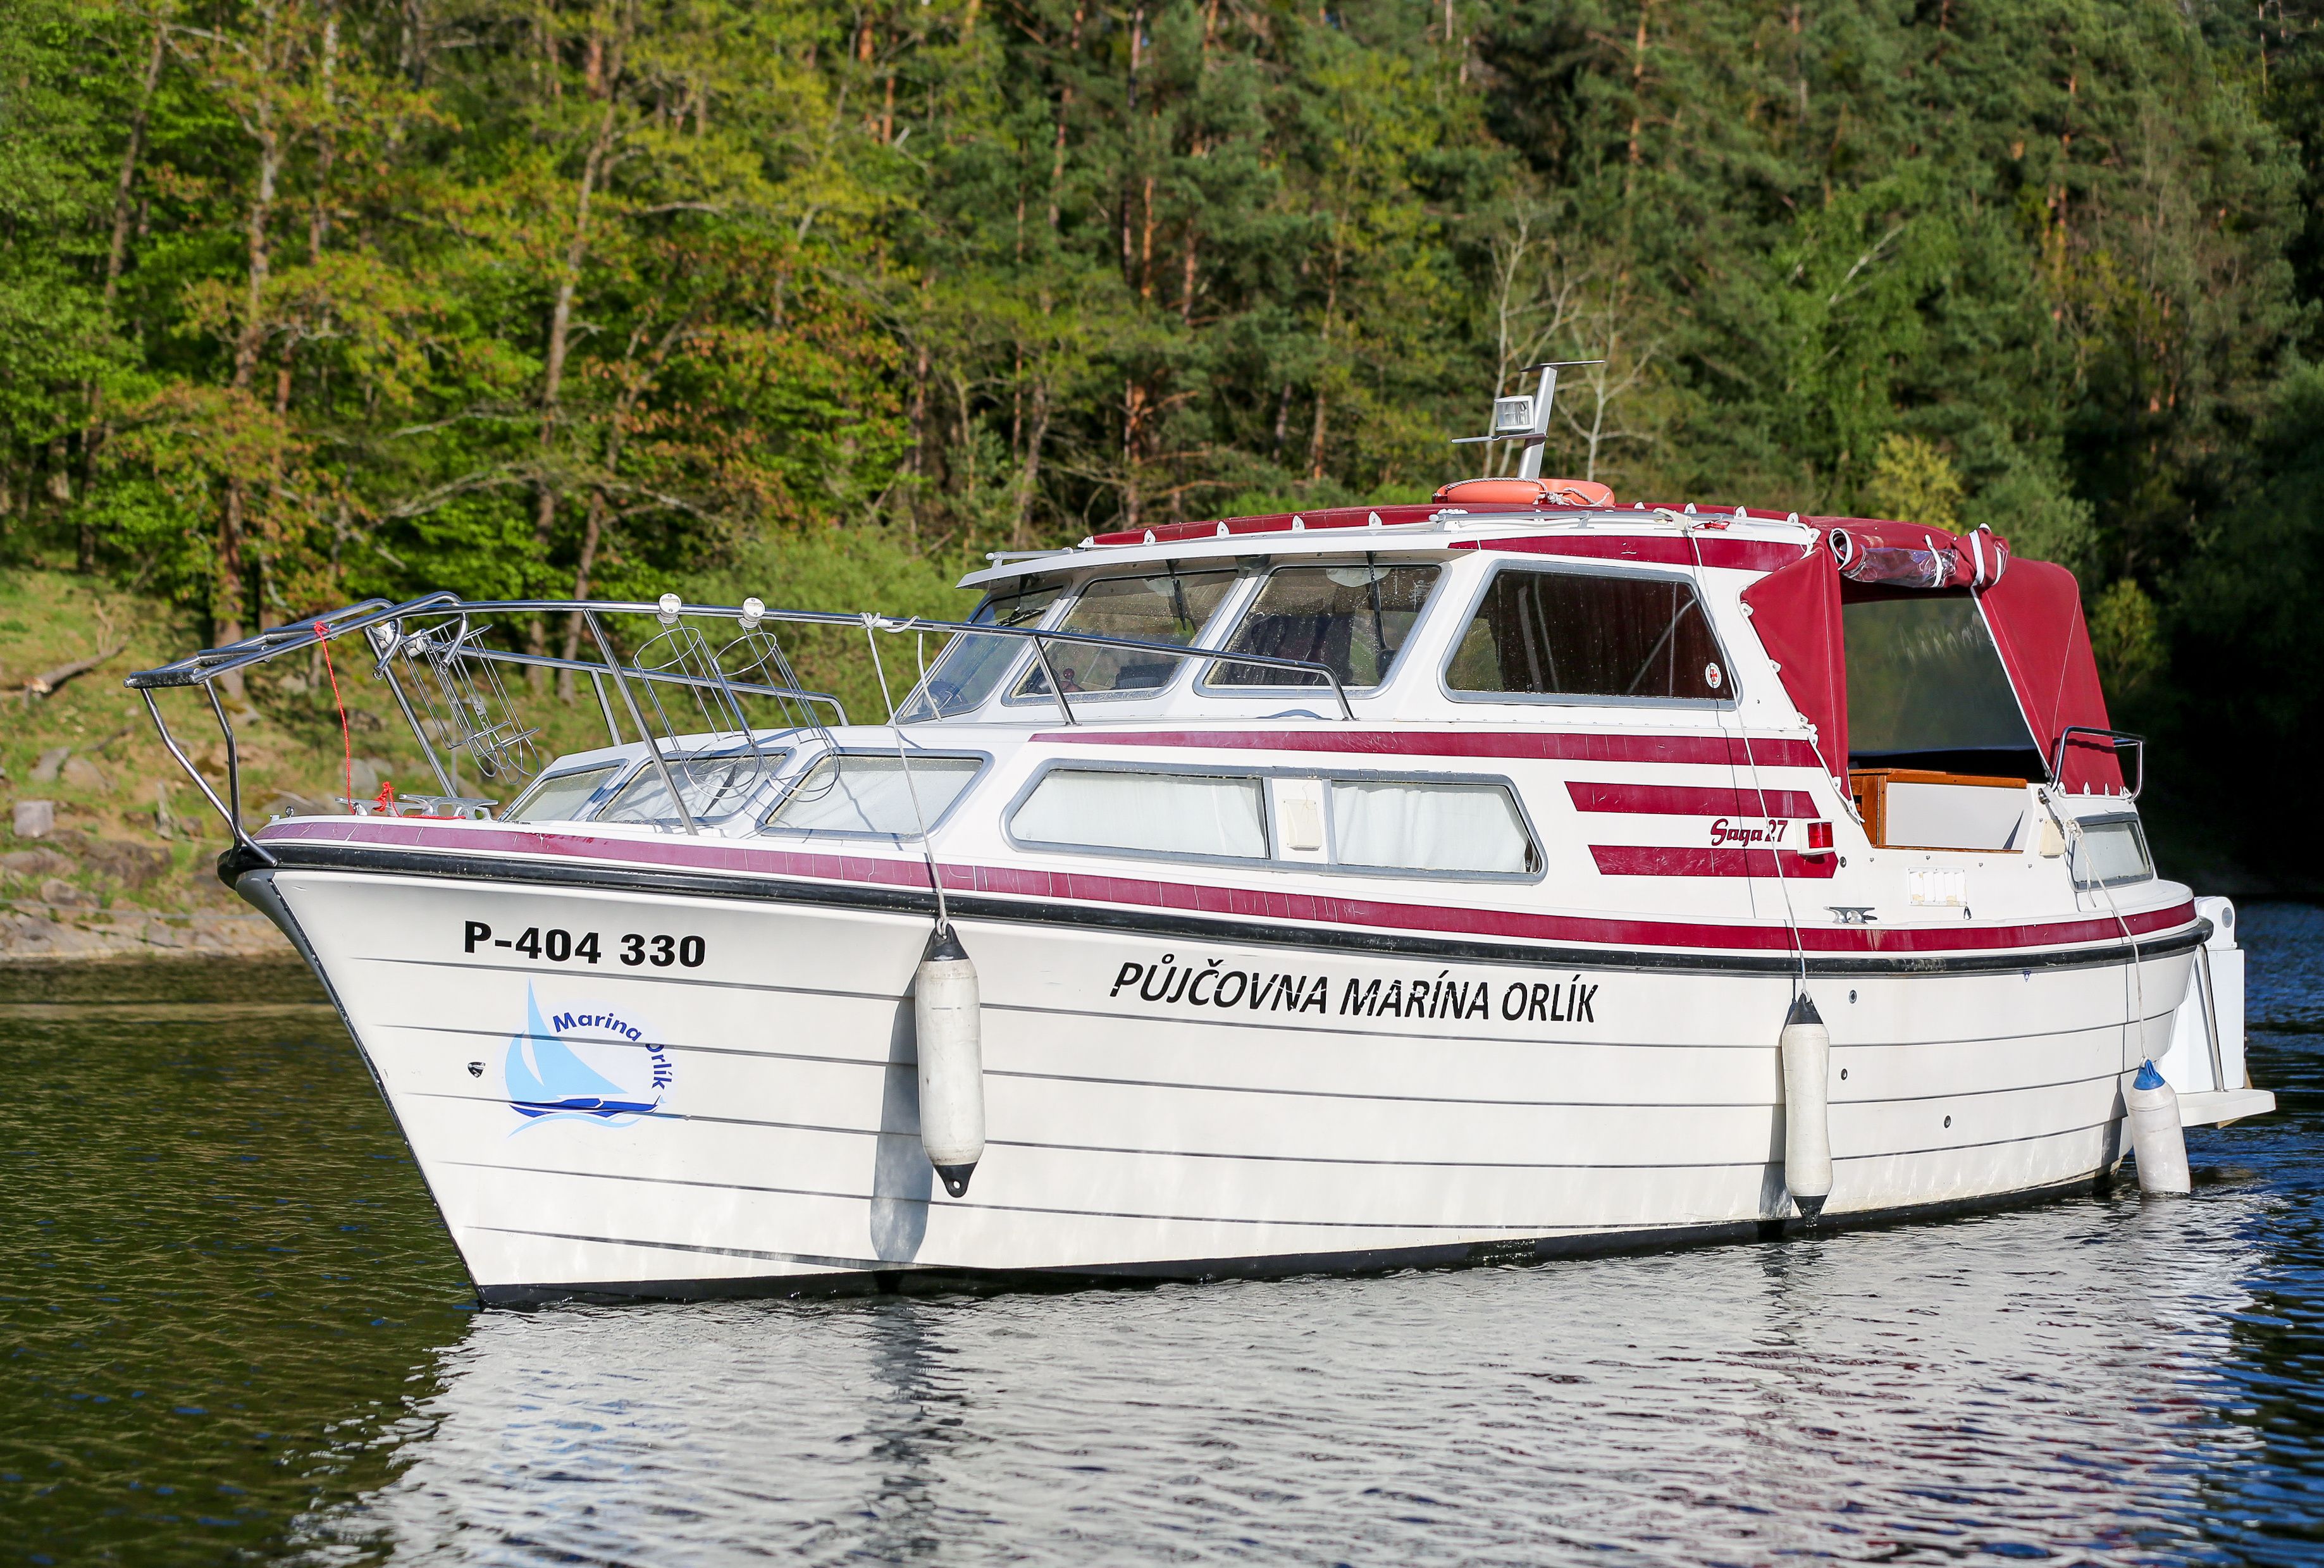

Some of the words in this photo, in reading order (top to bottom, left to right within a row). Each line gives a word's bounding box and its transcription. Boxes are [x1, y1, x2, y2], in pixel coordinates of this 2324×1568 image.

[1710, 818, 1764, 847] Saga
[1764, 818, 1788, 843] 27
[464, 920, 602, 965] P-404
[619, 934, 706, 968] 330
[1109, 953, 1328, 1014] PŮJČOVNA
[1339, 970, 1490, 1020] MARÍNA
[1501, 974, 1599, 1023] ORLÍK
[552, 1012, 643, 1042] Marina
